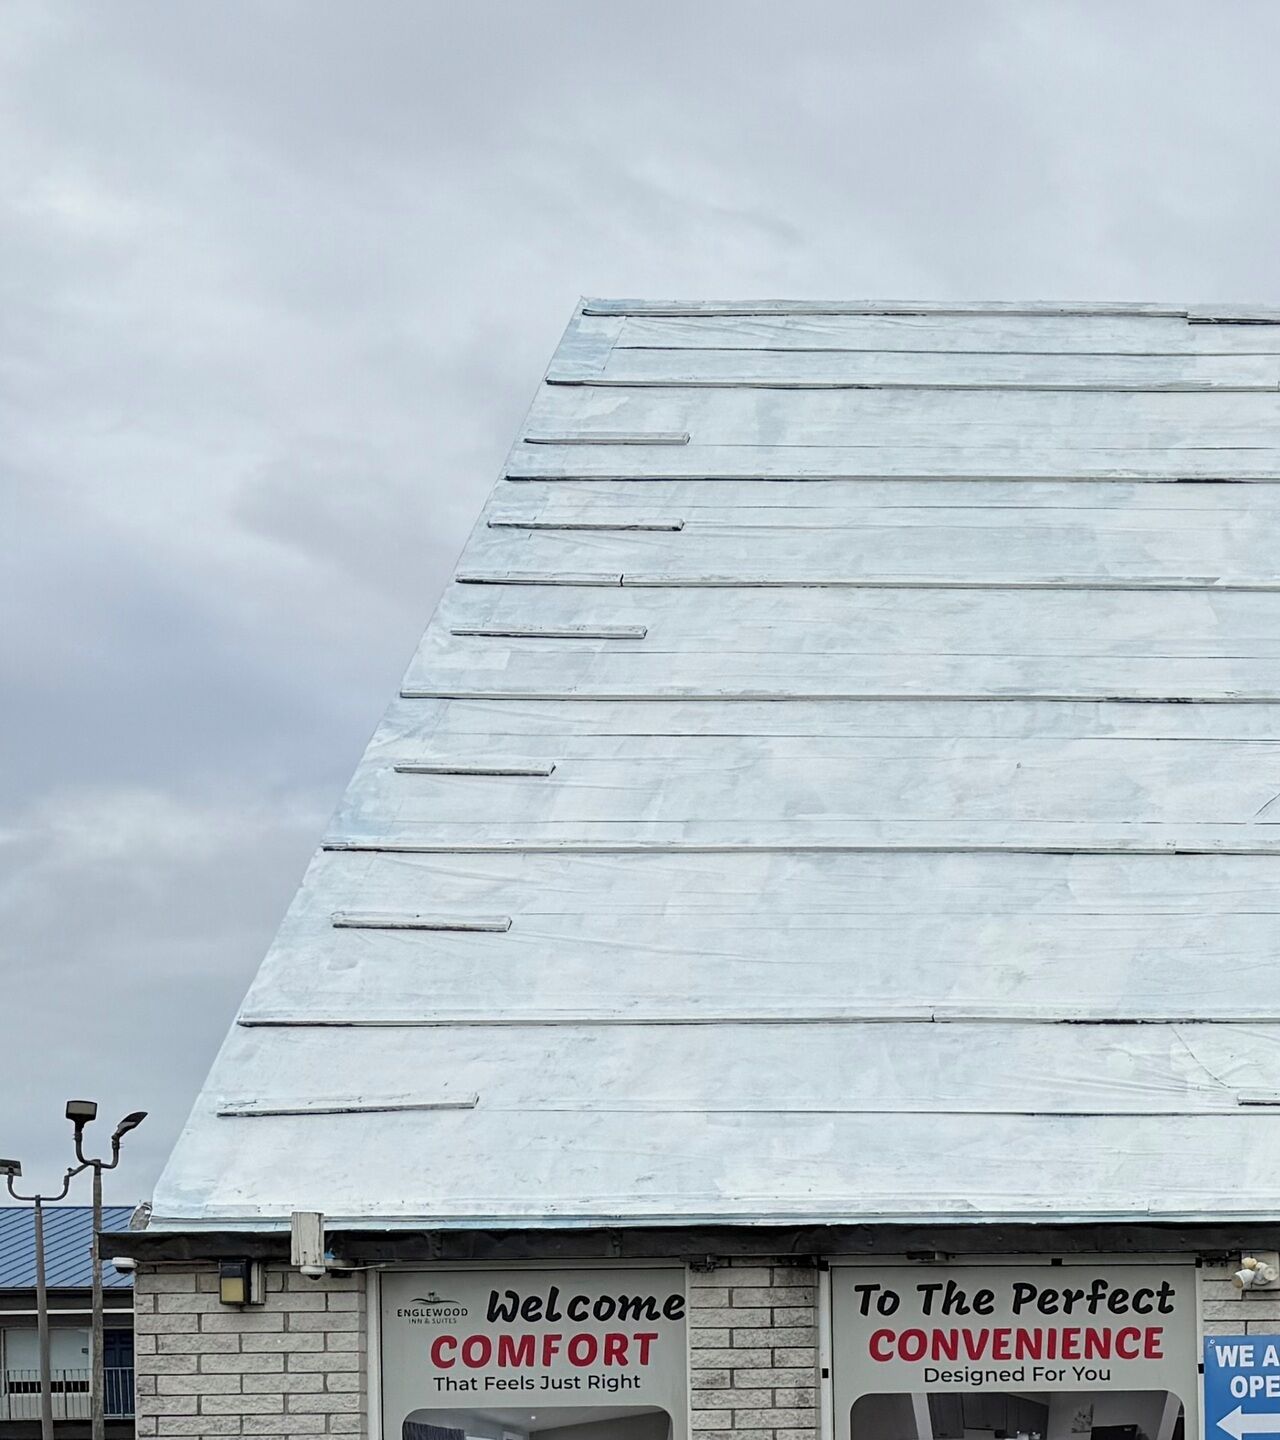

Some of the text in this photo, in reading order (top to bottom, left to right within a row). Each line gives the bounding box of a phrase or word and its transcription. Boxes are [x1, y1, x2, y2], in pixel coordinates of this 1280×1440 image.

[486, 1286, 686, 1322] Welcome
[854, 1279, 1175, 1316] To The Perfect
[397, 1307, 468, 1318] ENGLEWOOD
[430, 1332, 658, 1368] COMFORT
[868, 1326, 1164, 1362] CONVENIENCE
[1216, 1345, 1254, 1368] WE
[434, 1374, 640, 1392] That Feels Just Right
[924, 1366, 1111, 1386] Designed For You
